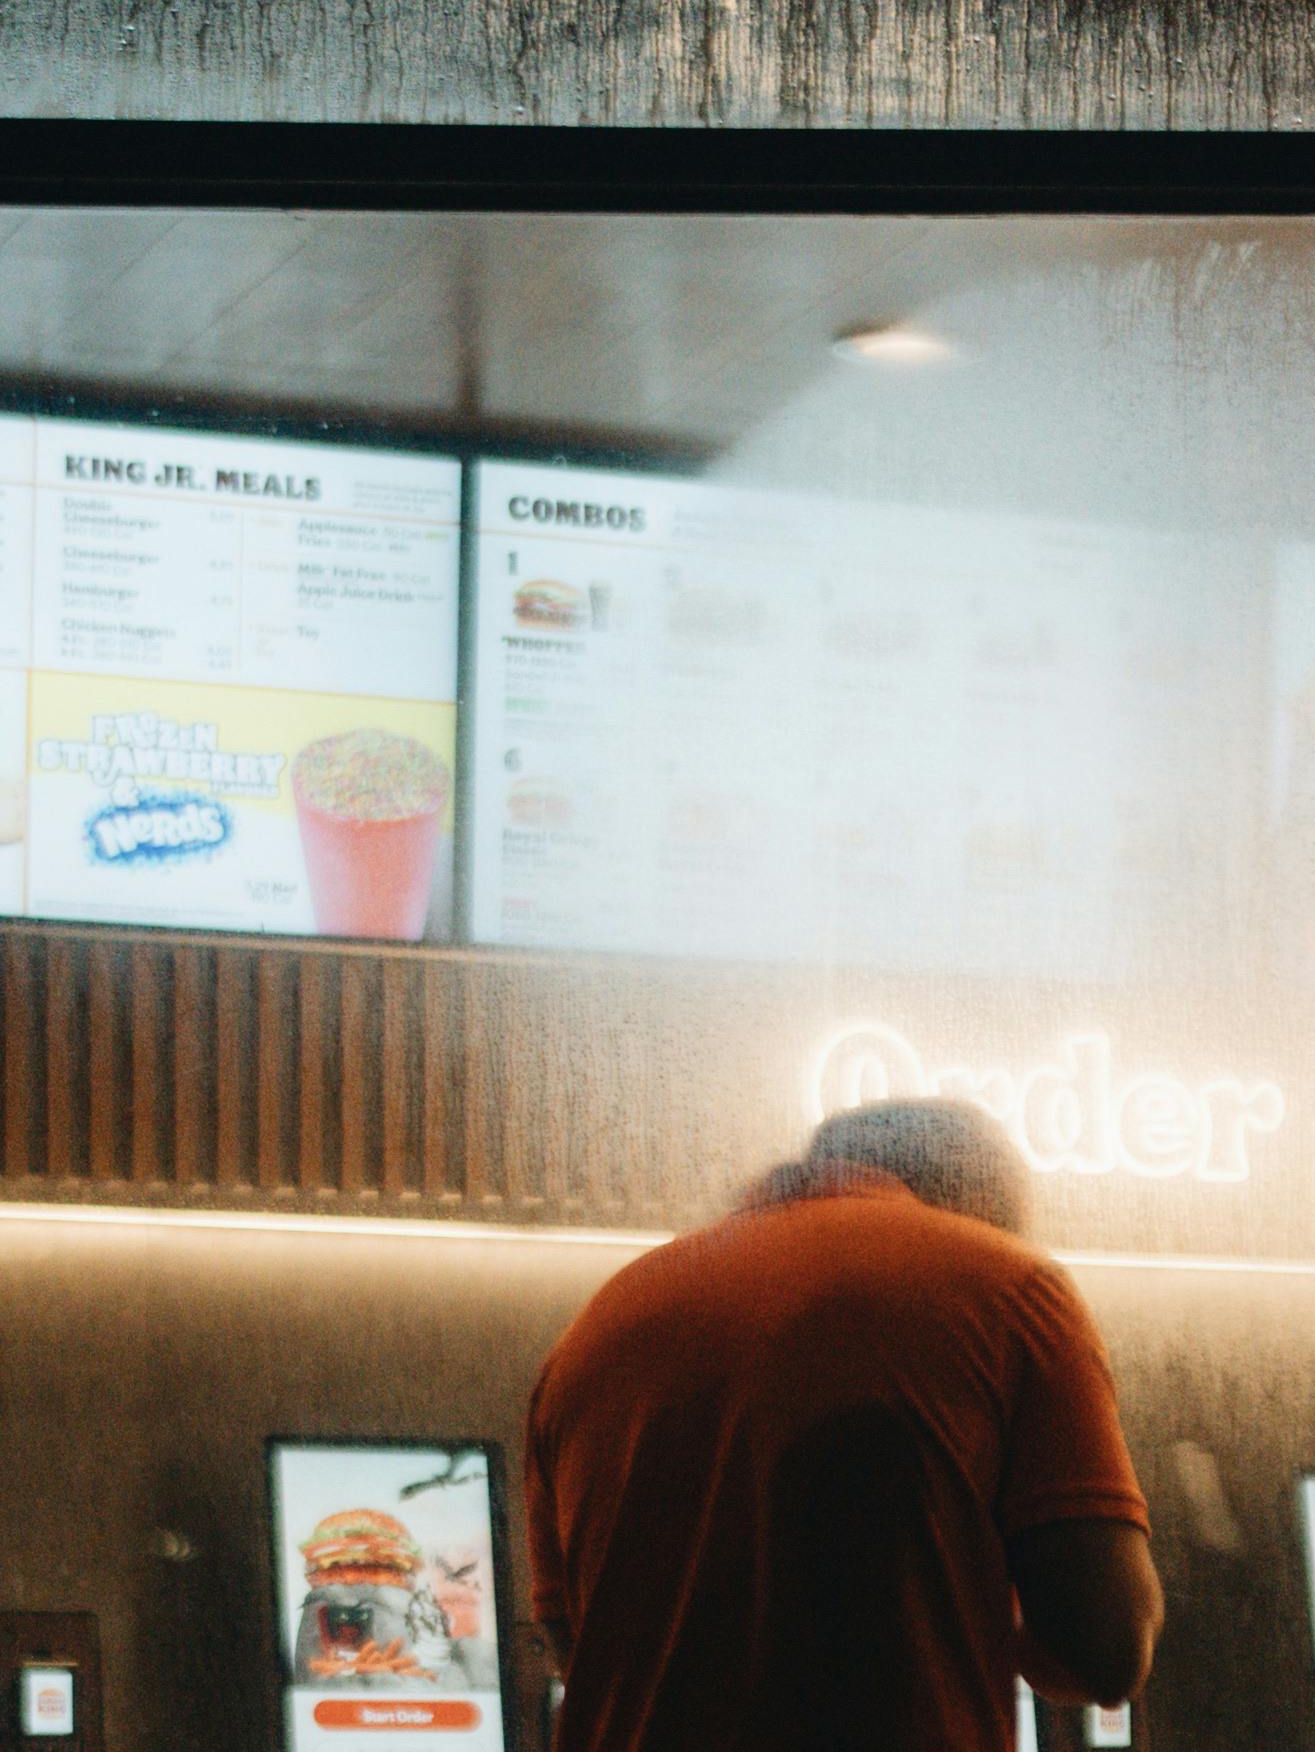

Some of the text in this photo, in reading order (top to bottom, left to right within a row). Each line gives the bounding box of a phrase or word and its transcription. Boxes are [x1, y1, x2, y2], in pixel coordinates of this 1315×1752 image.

[62, 453, 147, 486] KING
[153, 462, 208, 493] JR.
[213, 468, 323, 503] MEALS
[63, 512, 161, 532] Cheeseburger
[507, 494, 648, 534] COMBOS
[298, 535, 331, 548] Fries
[62, 546, 160, 566] Cheeseburger
[61, 581, 140, 600] Hamburger
[298, 583, 336, 598] Apple
[339, 584, 375, 600] Juice
[37, 738, 287, 788] STRAWBERRY
[500, 746, 524, 775] 6
[361, 1709, 434, 1725] Start Order
